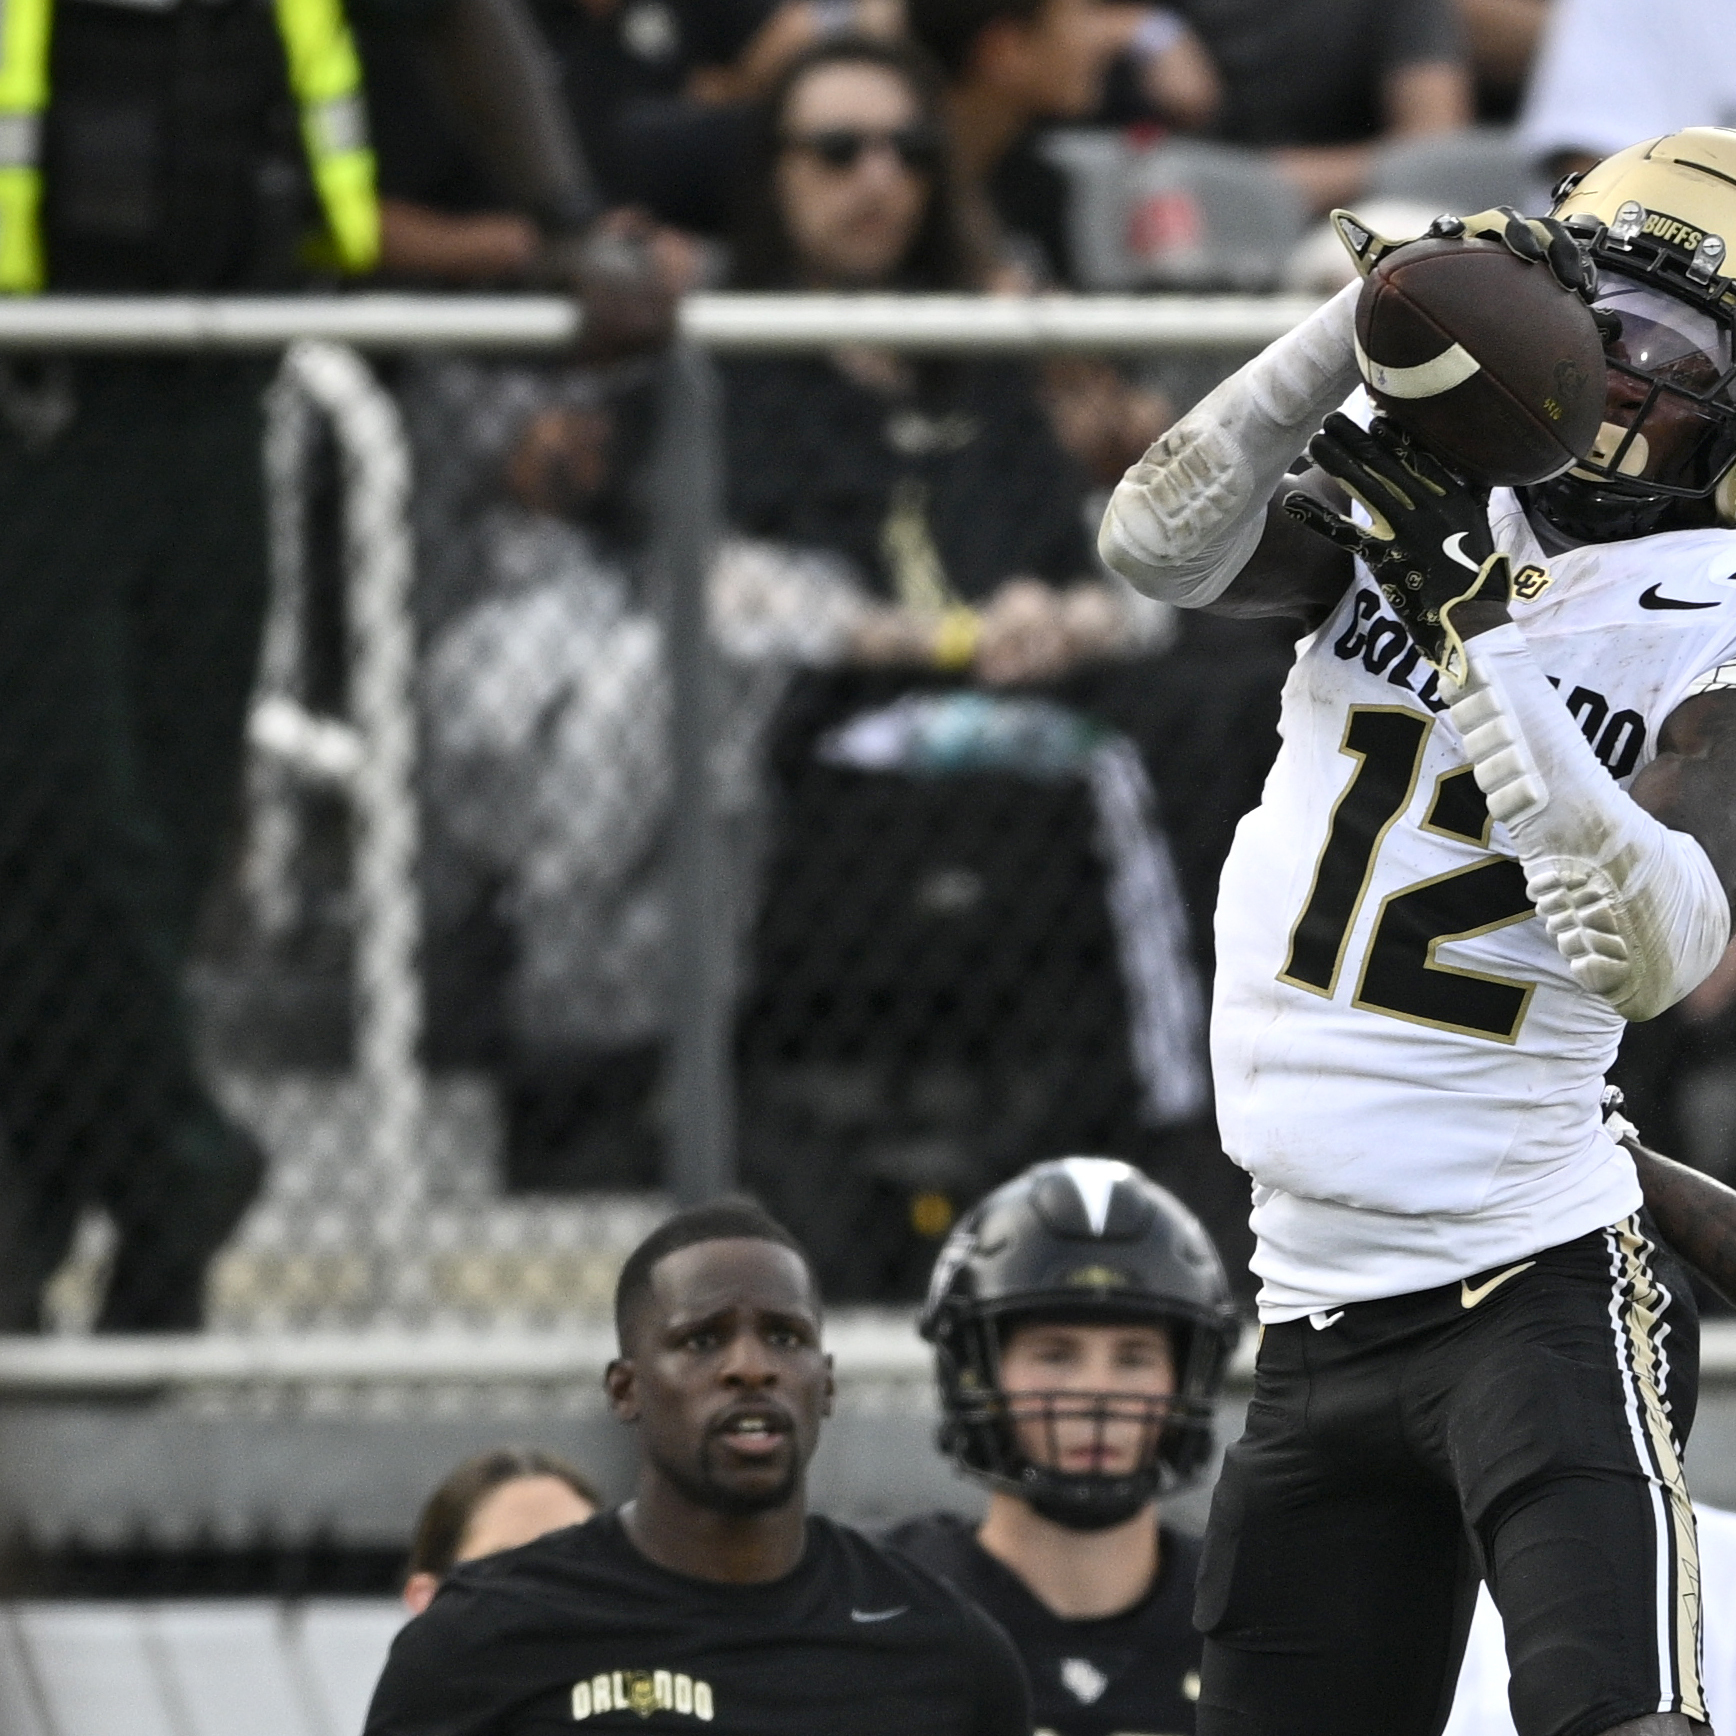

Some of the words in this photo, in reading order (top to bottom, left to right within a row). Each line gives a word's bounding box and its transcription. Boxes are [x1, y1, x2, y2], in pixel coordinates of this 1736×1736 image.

[1644, 213, 1702, 251] BUFFS
[1334, 588, 1646, 780] COLDO
[1276, 704, 1540, 1045] 12
[571, 1668, 715, 1722] ORLNDO
